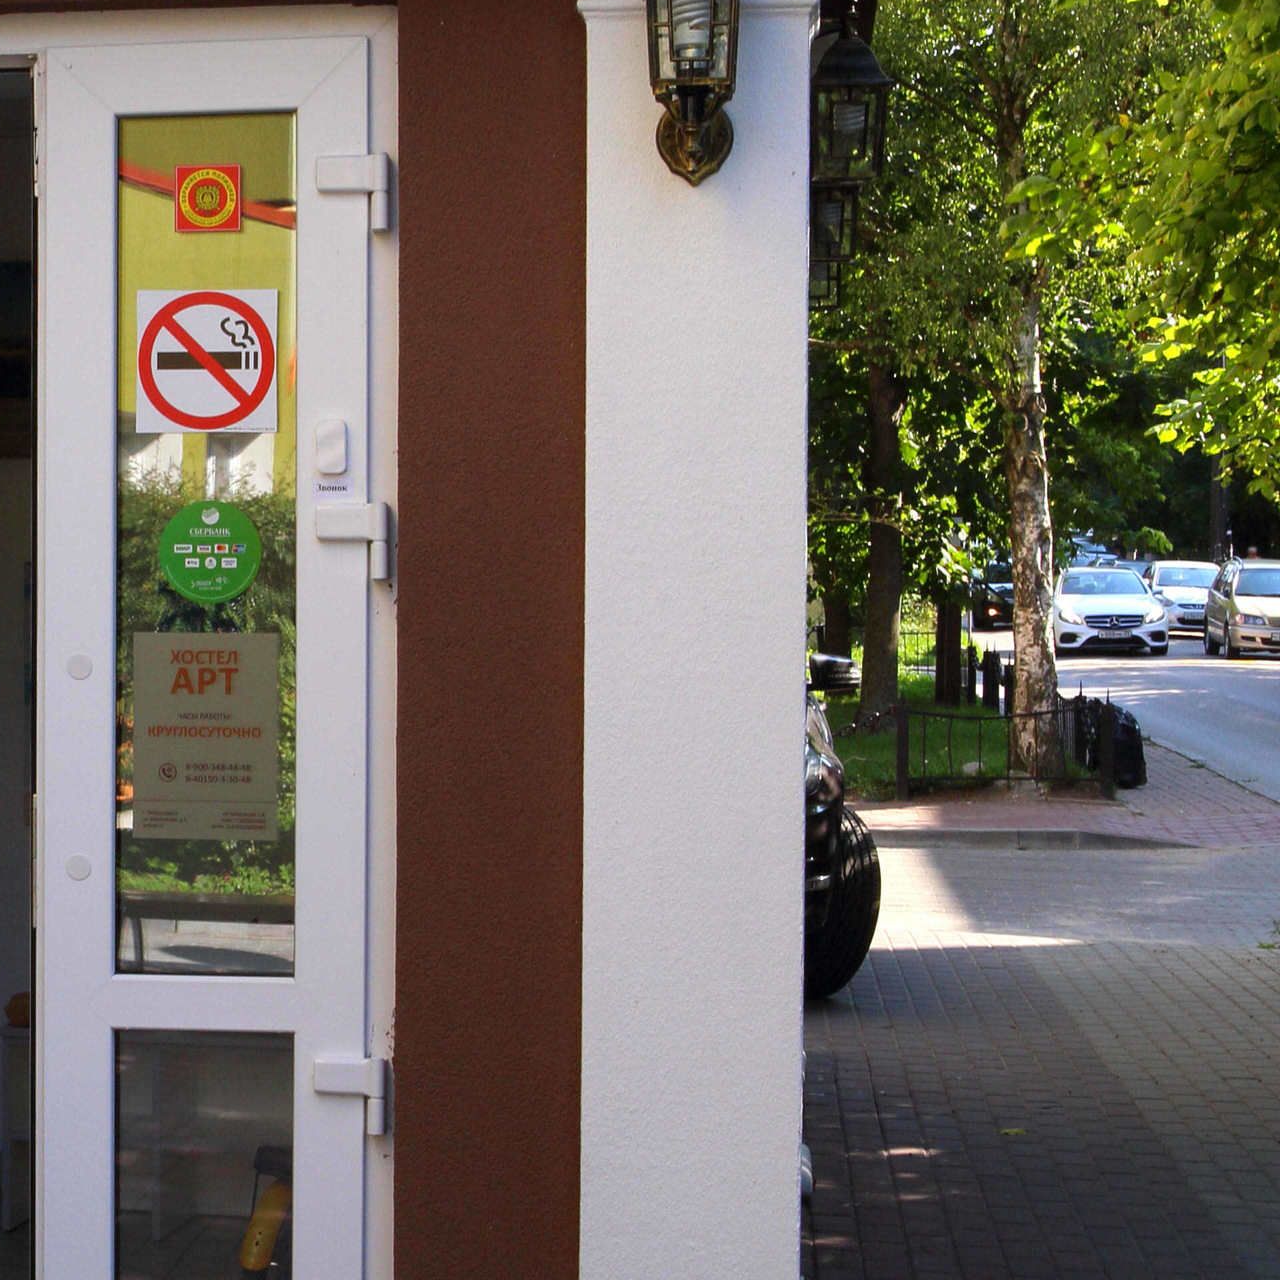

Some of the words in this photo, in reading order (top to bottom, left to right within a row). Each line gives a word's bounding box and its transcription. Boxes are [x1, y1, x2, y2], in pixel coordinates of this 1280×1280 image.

[189, 527, 231, 537] СБЕРБАНК
[170, 649, 239, 665] ХОСТЕЛ
[170, 666, 239, 696] АРТ
[147, 724, 262, 739] КРУГЛОСУТОЧНО
